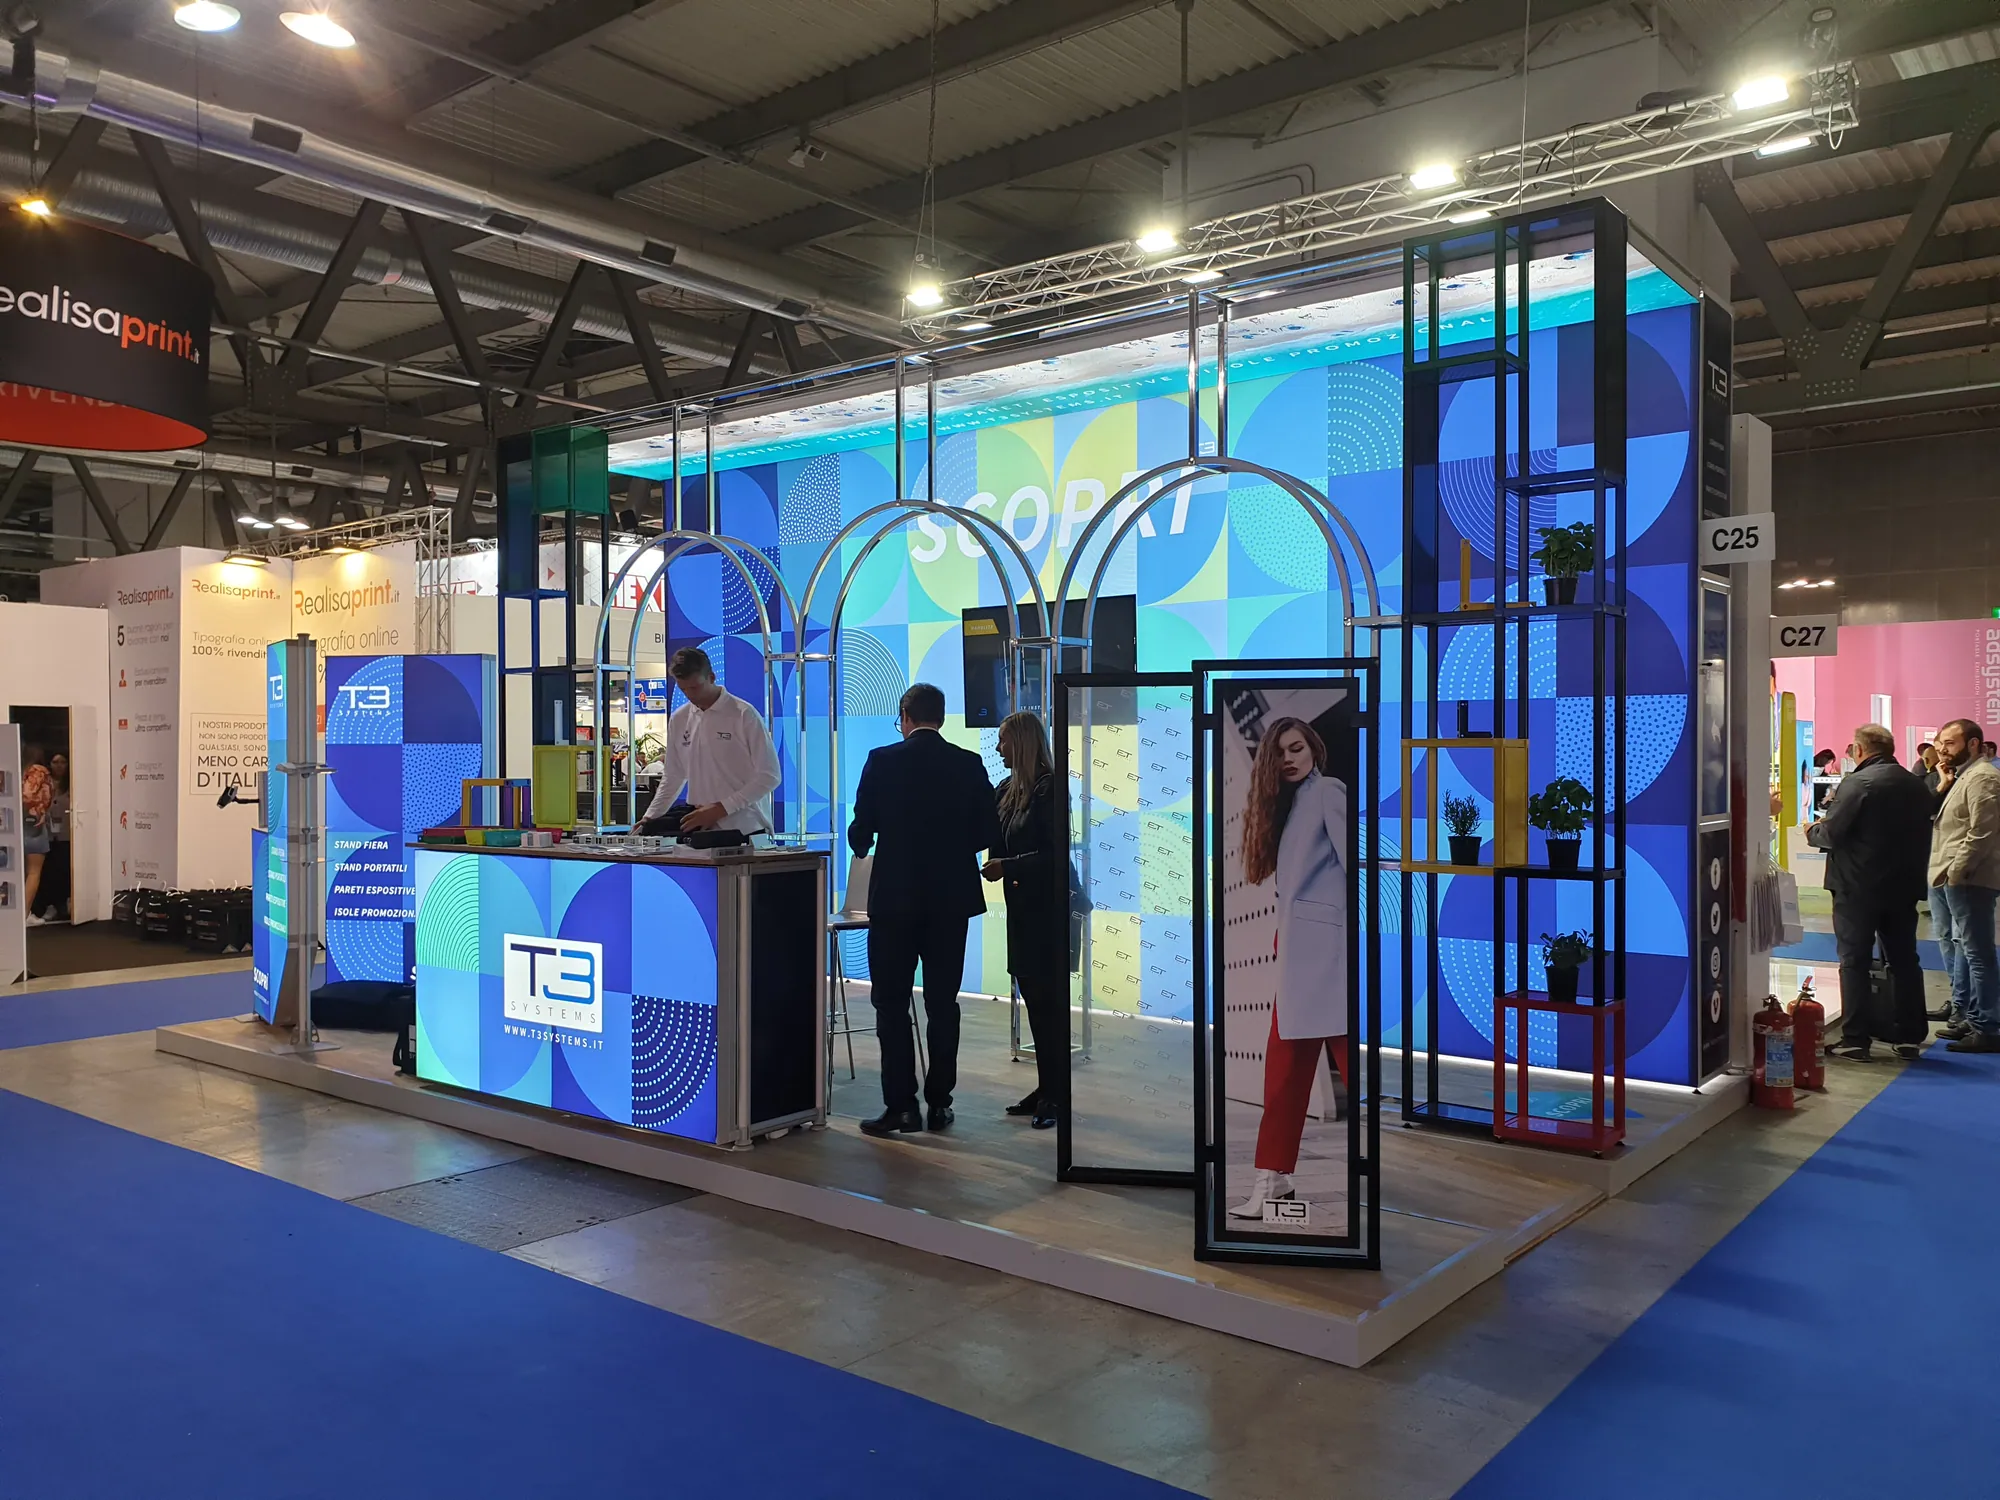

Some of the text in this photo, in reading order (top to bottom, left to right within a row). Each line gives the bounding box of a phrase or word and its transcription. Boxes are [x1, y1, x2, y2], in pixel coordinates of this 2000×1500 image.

[1043, 376, 1173, 403] ESPOSITIVE
[1707, 360, 1727, 398] T3
[911, 465, 1197, 563] SCOPRI
[1711, 526, 1759, 551] C25
[294, 579, 400, 617] Realisaprint.it
[117, 625, 125, 647] 5
[193, 631, 245, 646] Tipografia
[360, 624, 399, 649] online
[1780, 626, 1826, 647] C27
[192, 645, 224, 657] 100%
[269, 674, 284, 701] T3
[338, 685, 390, 709] T3
[202, 721, 232, 729] NOSTRI
[243, 744, 267, 752] SONO
[197, 756, 238, 767] MENO
[334, 841, 389, 850] STAND FIERA
[334, 863, 408, 873] STAND PORTATILI
[334, 886, 364, 895] PARETI
[334, 908, 416, 918] ISOLE PROMOZION
[510, 943, 596, 1005] T3
[511, 1001, 596, 1024] SYSTEMS
[504, 1024, 604, 1050] WWW.T3SYSTEMS.IT
[1265, 1201, 1306, 1218] T3
